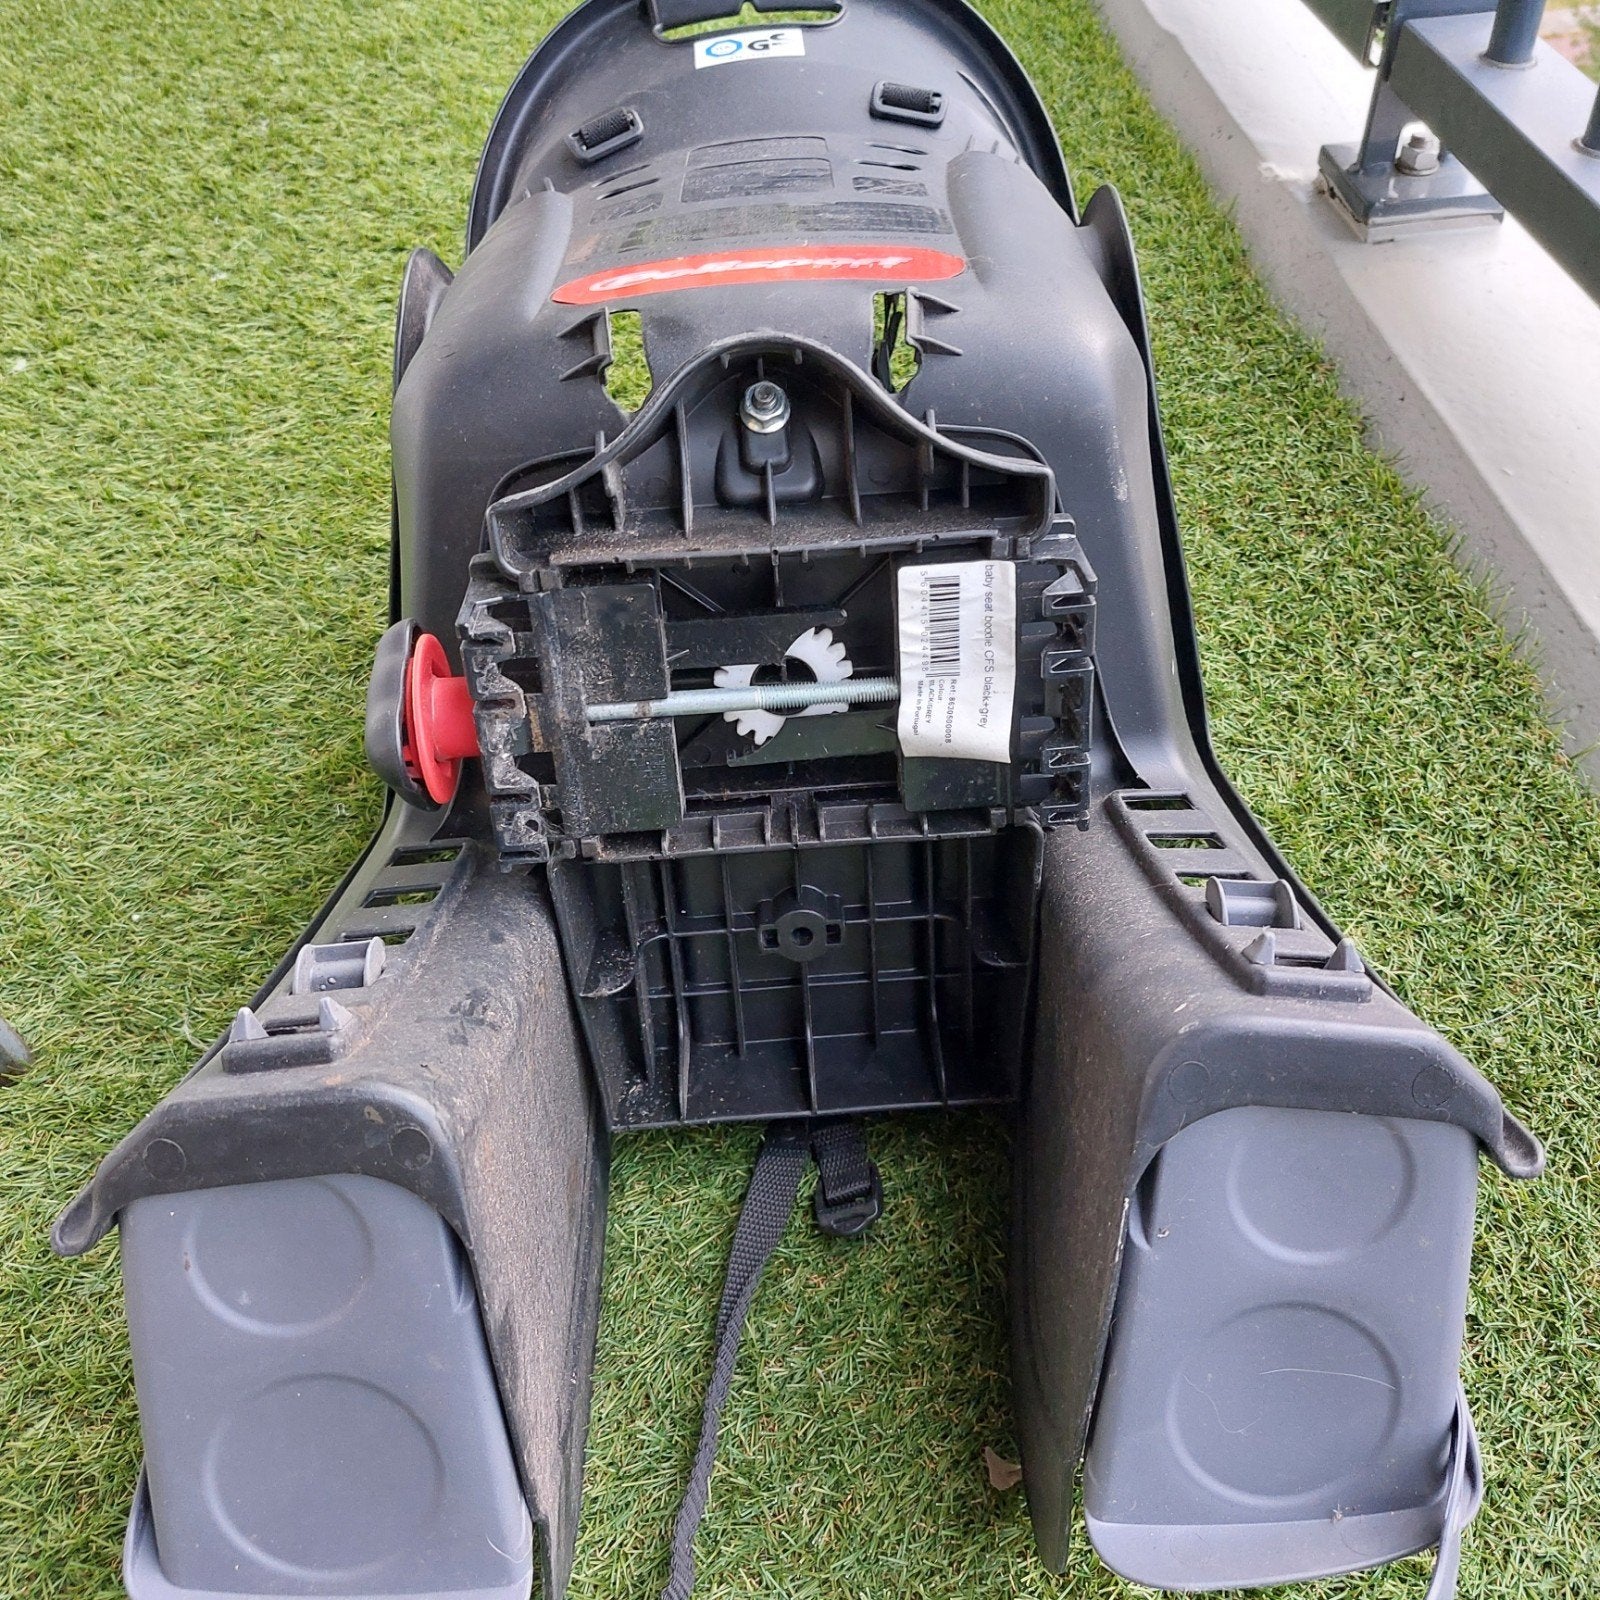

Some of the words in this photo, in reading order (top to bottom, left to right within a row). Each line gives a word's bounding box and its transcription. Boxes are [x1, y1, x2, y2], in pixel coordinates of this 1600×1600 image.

[983, 564, 994, 588] baby
[984, 591, 994, 612] seat
[984, 650, 994, 673] CFS
